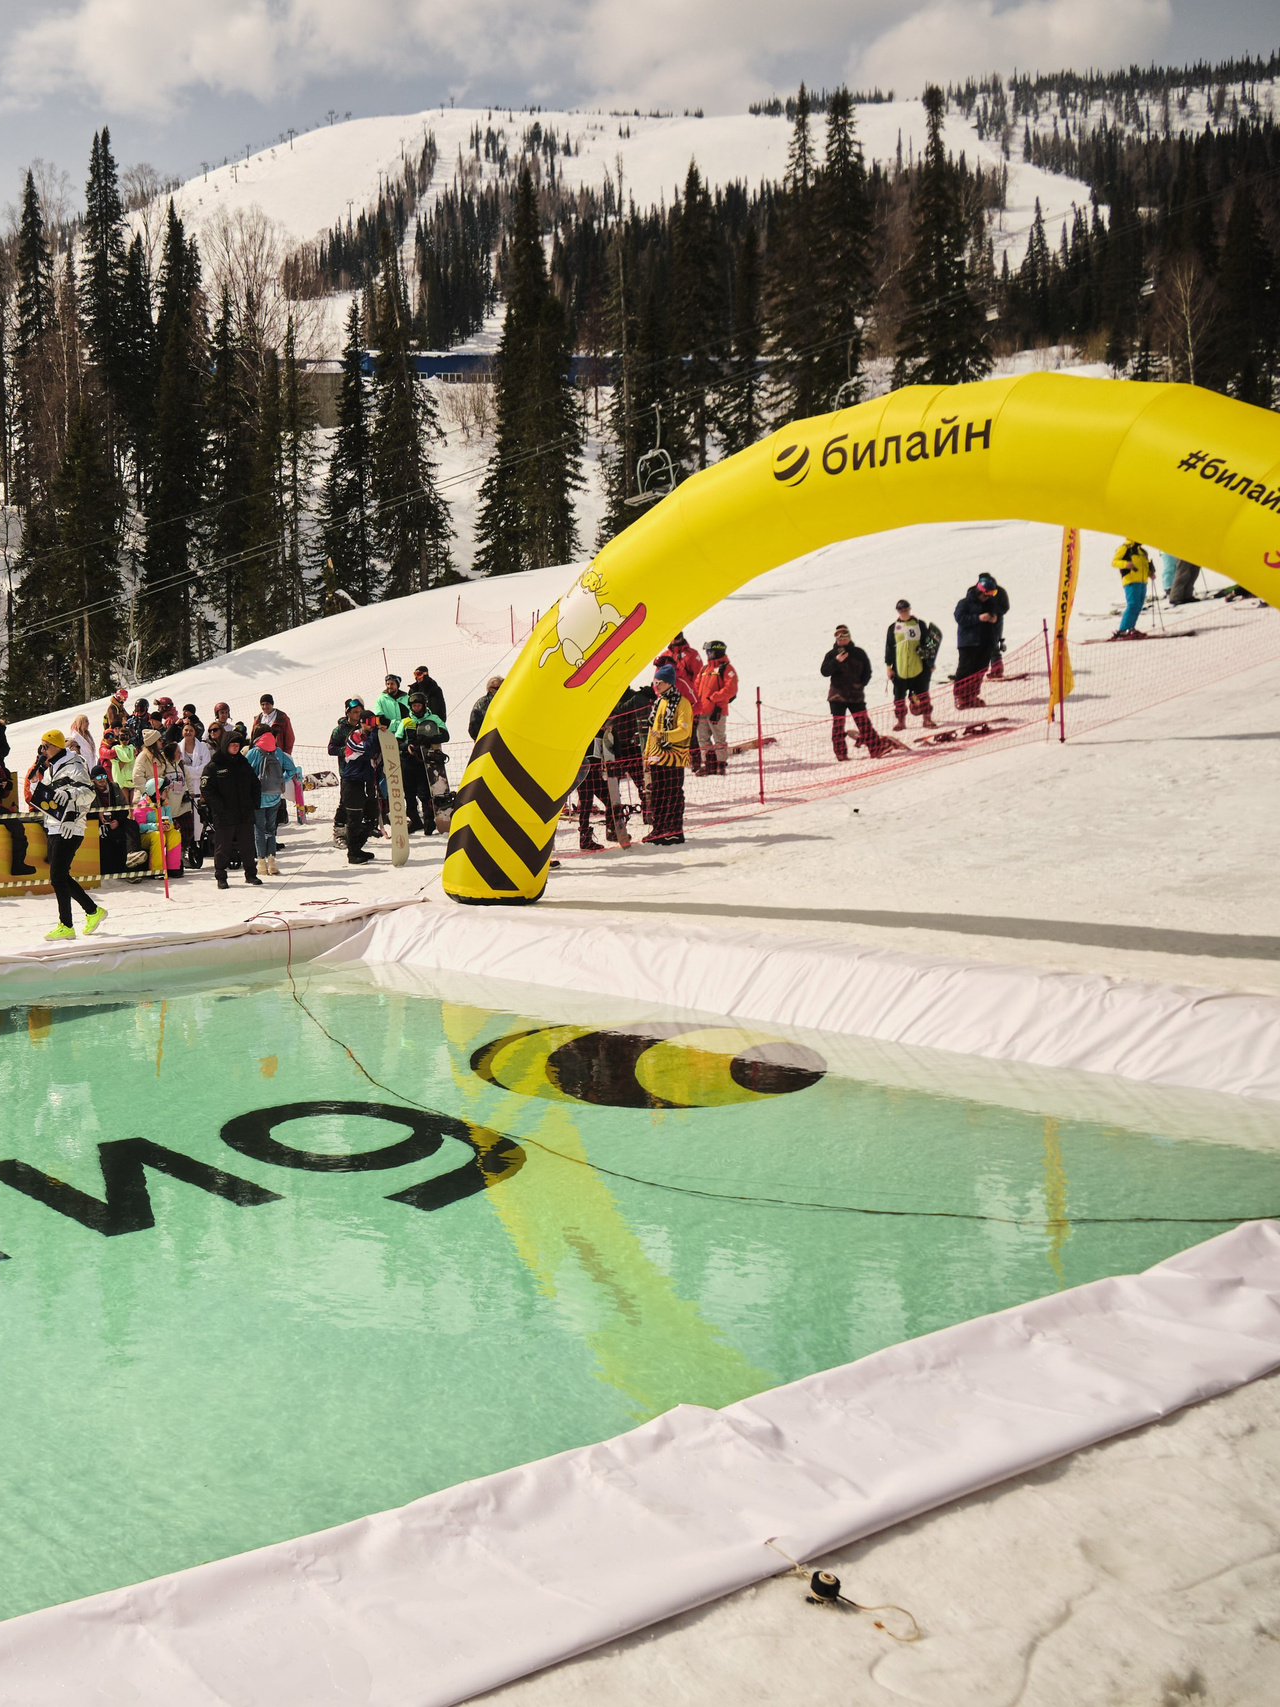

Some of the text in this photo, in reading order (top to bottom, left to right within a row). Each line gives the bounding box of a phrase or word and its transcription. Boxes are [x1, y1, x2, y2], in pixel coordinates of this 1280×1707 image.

[822, 415, 992, 475] билайн
[1177, 450, 1280, 514] #билай
[387, 759, 403, 826] ARBOR
